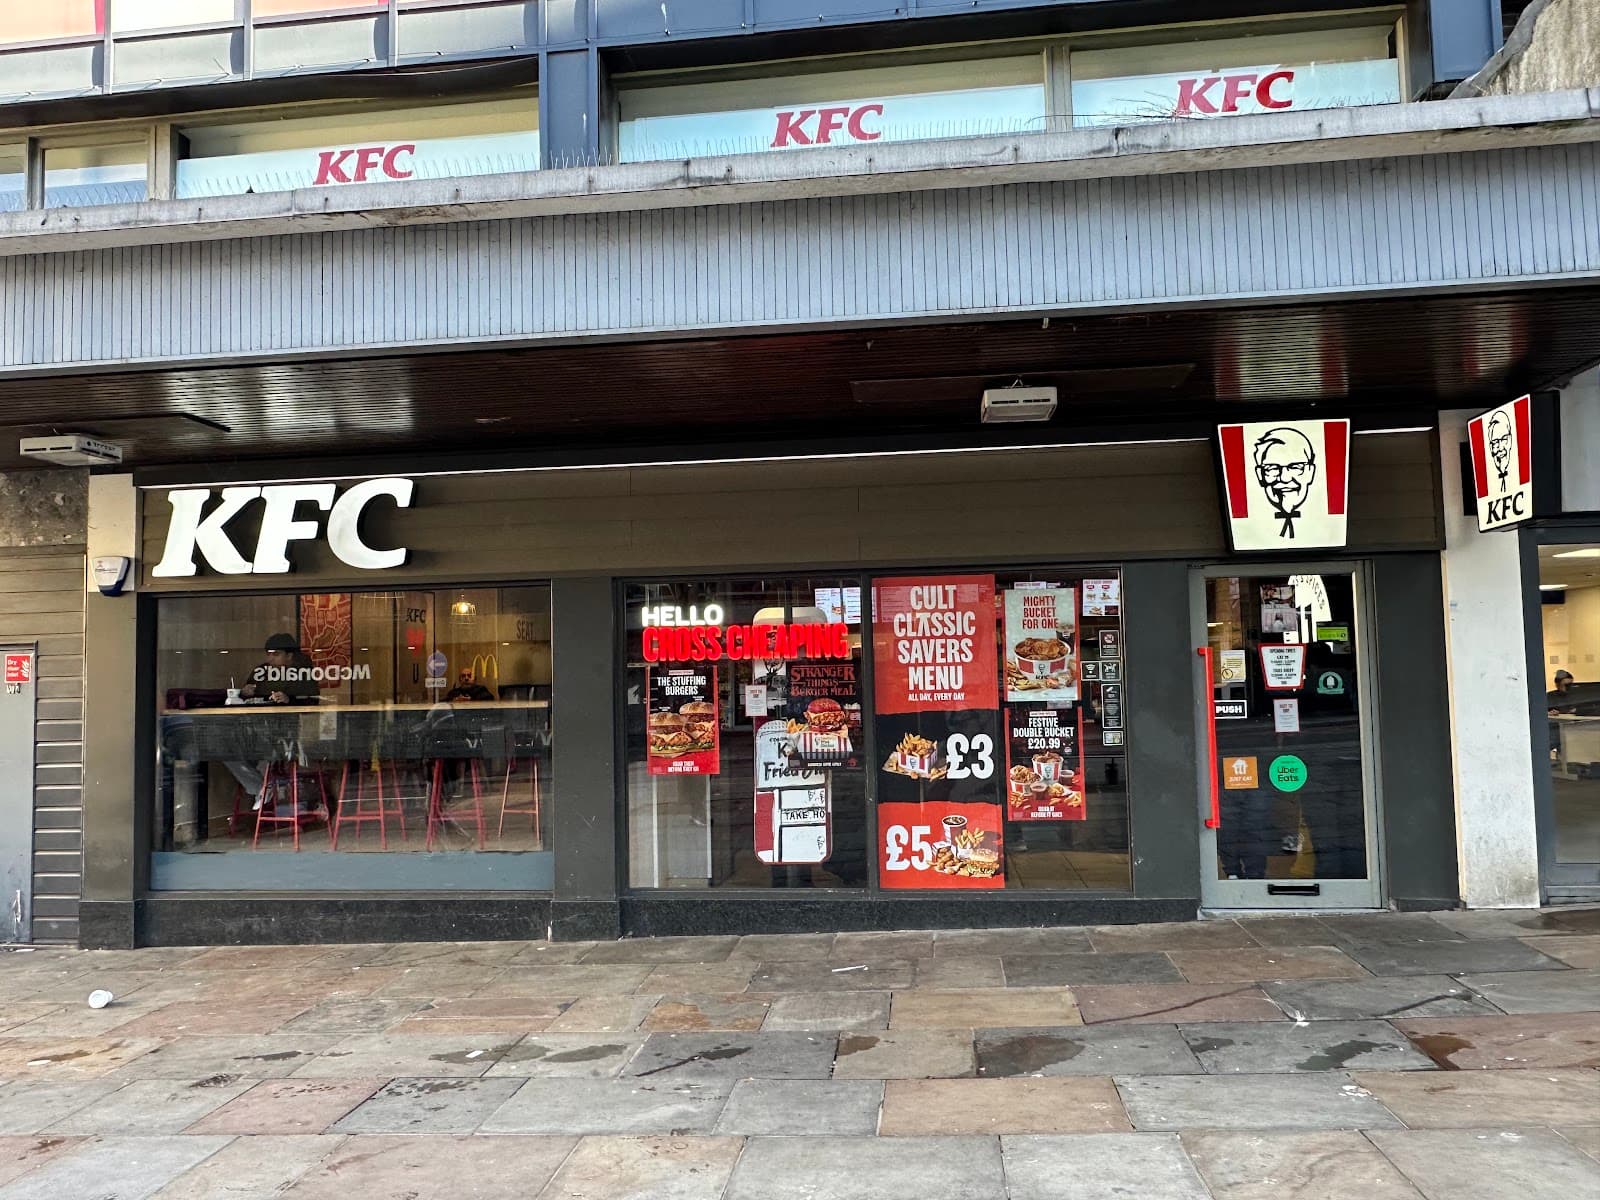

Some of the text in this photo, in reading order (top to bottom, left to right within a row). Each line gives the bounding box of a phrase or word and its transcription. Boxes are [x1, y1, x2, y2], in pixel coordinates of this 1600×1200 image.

[1173, 71, 1295, 116] KFC
[770, 104, 883, 148] KFC
[312, 144, 416, 185] KFC
[1486, 491, 1524, 525] KFC
[152, 477, 413, 577] KFC
[910, 584, 957, 610] CULT
[1023, 595, 1056, 607] MIGHTY
[405, 607, 427, 624] KFC
[641, 604, 724, 627] HELLO
[1023, 607, 1057, 618] BUCKET
[893, 611, 976, 637] CLASSIC
[1022, 618, 1059, 629] FOR ONE
[642, 622, 849, 662] CROSS CHEAPING
[898, 638, 973, 664] SAVERS
[790, 665, 856, 681] STRANGER
[908, 666, 963, 690] MENU
[657, 676, 706, 687] THE STUFFING
[806, 679, 839, 687] THINGS
[665, 686, 698, 696] BURGERS
[830, 684, 857, 696] MEAL
[908, 693, 918, 701] ALL
[934, 693, 952, 701] EVERY
[953, 692, 965, 700] DAY
[1215, 705, 1242, 714] PUSH
[1028, 717, 1059, 728] FESTIVE
[1013, 726, 1074, 738] DOUBLE BUCKET
[1028, 738, 1061, 750] £20.99
[946, 733, 995, 780] £3
[1277, 766, 1300, 774] Uber
[1277, 774, 1300, 782] Eats
[784, 810, 808, 820] TAKE
[885, 825, 934, 871] £5
